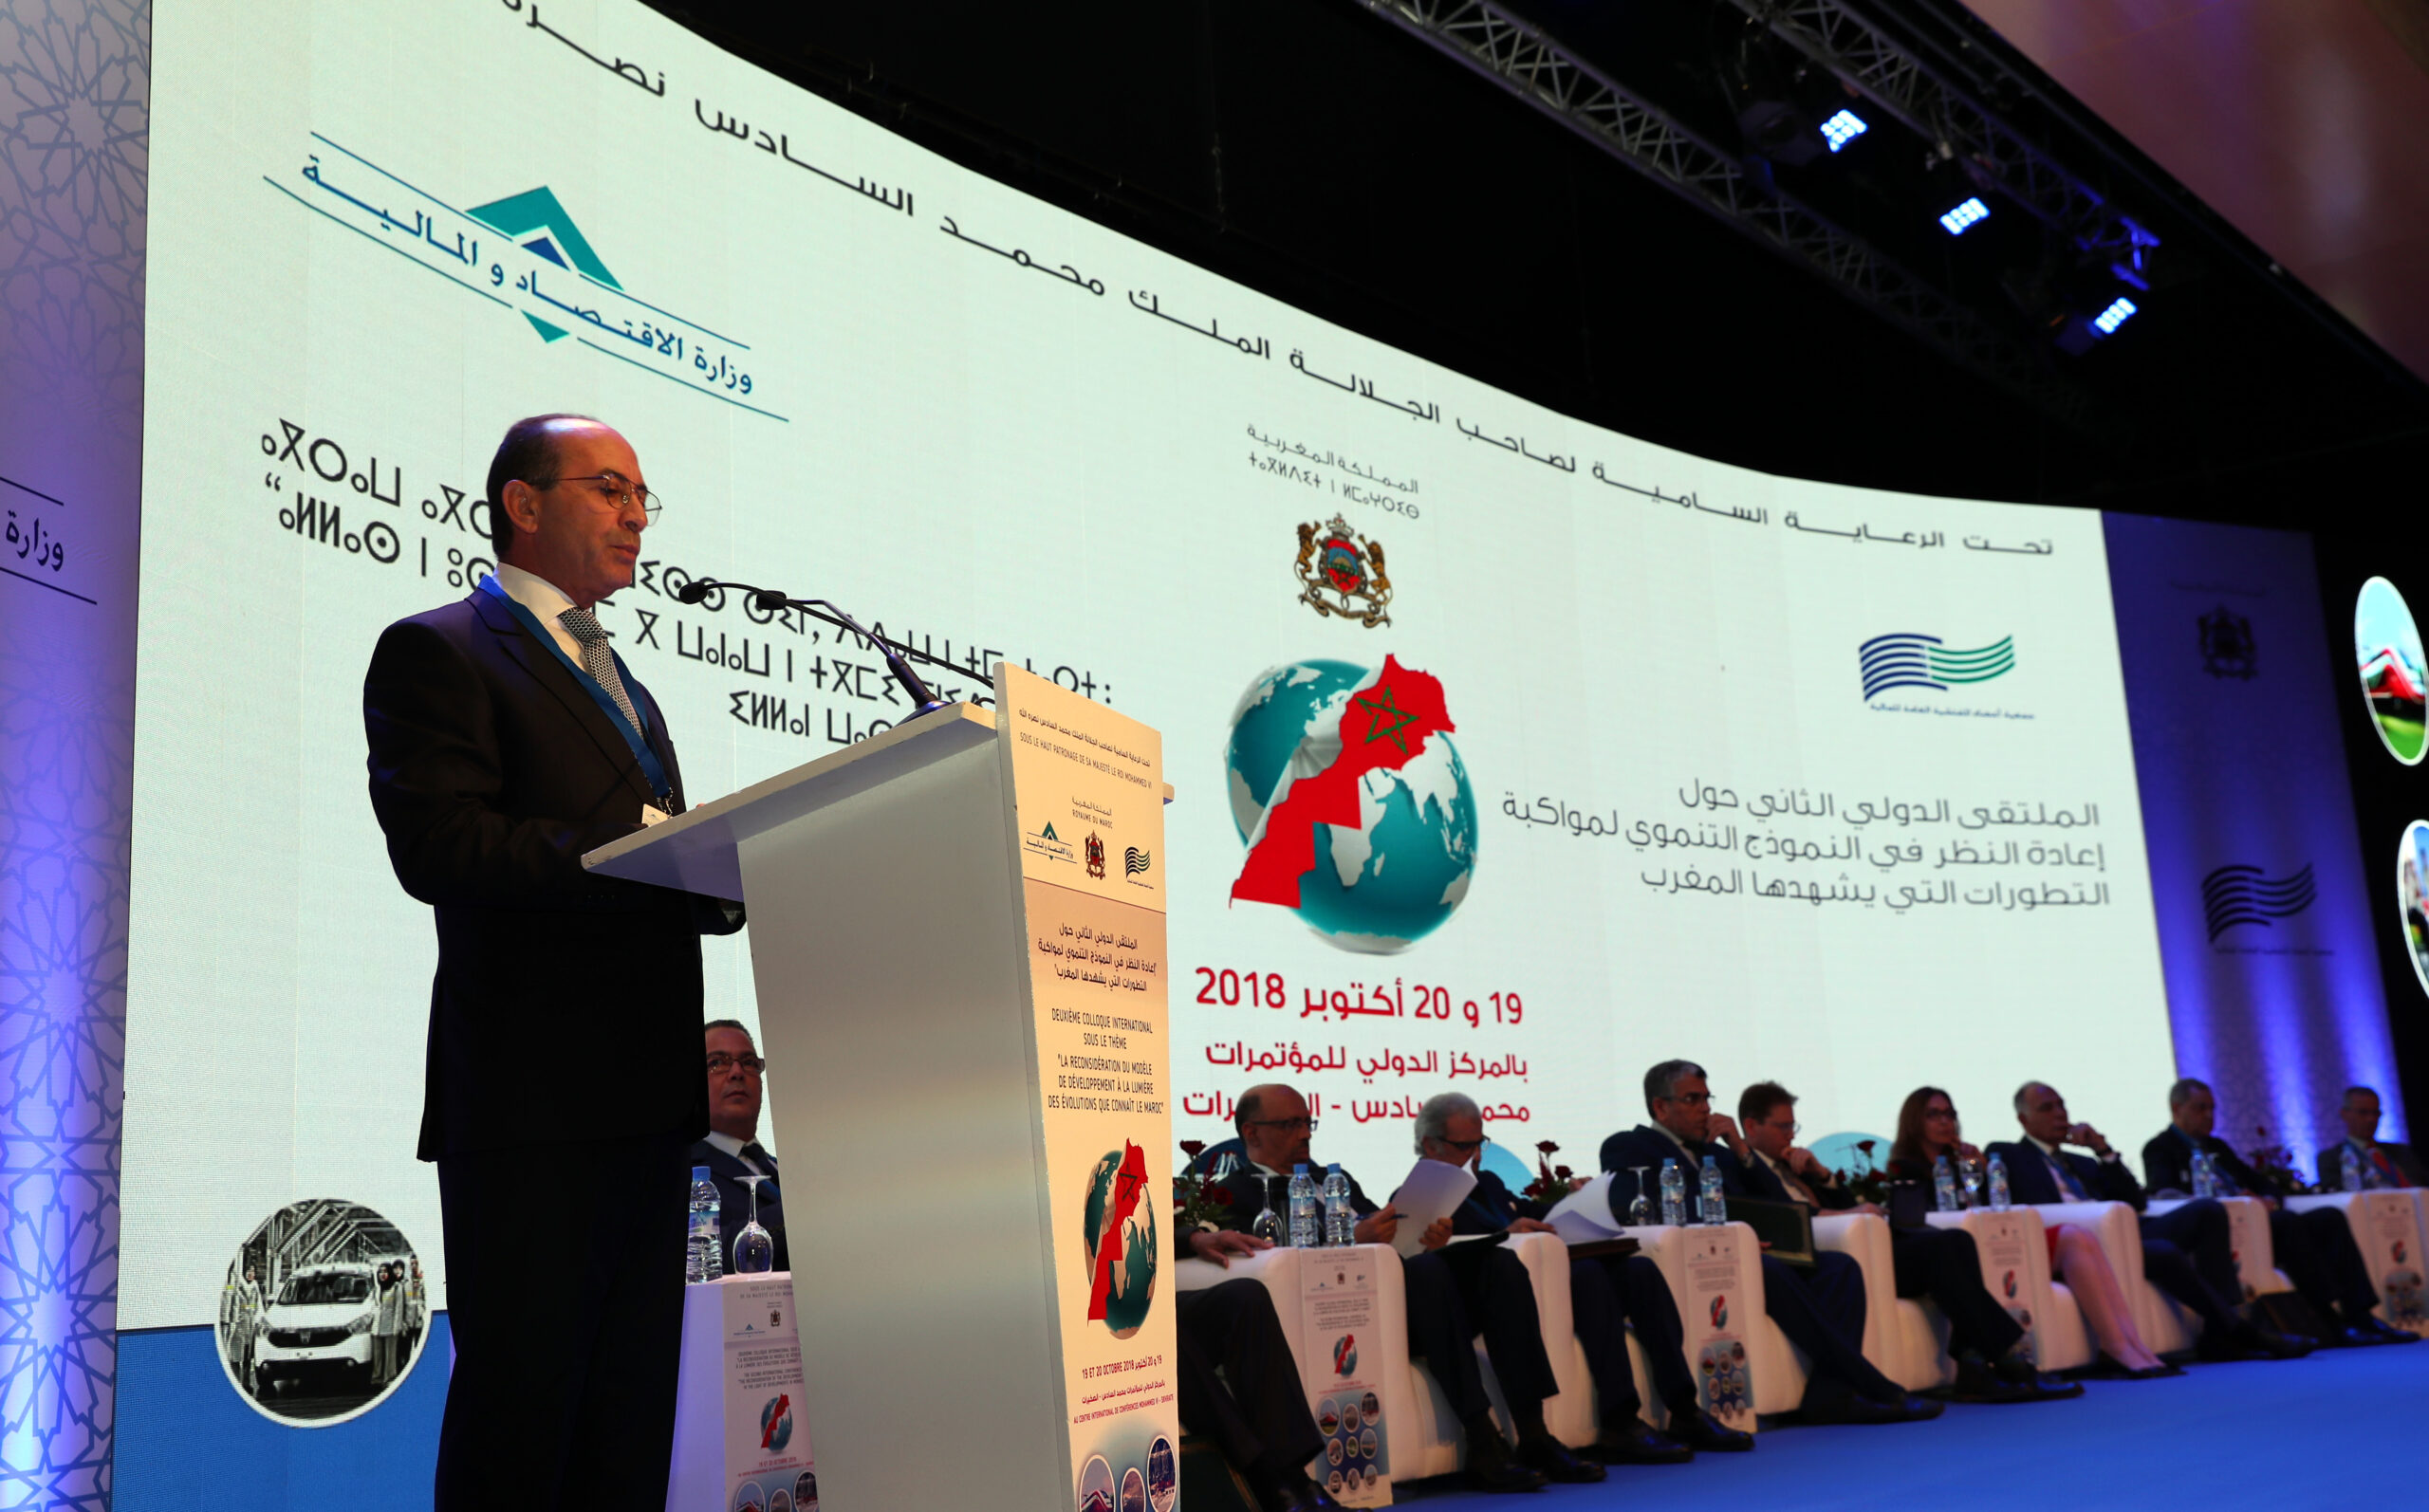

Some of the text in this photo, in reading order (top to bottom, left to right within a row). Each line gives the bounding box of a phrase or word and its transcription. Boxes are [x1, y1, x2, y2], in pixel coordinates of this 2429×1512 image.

[695, 98, 914, 218] السادس
[302, 155, 753, 396] وزارة الاقتصاد و المالية
[939, 214, 1105, 297] محمد
[1127, 286, 1271, 361] الملك
[1289, 347, 1439, 425] الجلالة
[261, 417, 401, 508] ⴰⴳⵔⴰⵡ
[1246, 423, 1419, 494] المملكة المغربية
[1456, 417, 1576, 474] لصاحب
[1592, 461, 1769, 526] السامية
[5, 508, 65, 573] وزارة
[1783, 509, 1944, 548] الرعاية
[1962, 533, 2054, 556] تحت
[1019, 731, 1033, 745] SOUS
[1033, 737, 1040, 747] LE
[1040, 740, 1053, 752] HAUT
[1053, 744, 1080, 763] PATRONAGE
[1079, 753, 1085, 765] DE
[1085, 756, 1093, 767] SA
[1111, 767, 1117, 777] LE
[1071, 808, 1091, 823] ROYAUME
[1092, 815, 1099, 825] DU
[1679, 776, 2100, 830] الملتقى الدولي الثاني حول
[1502, 790, 2105, 872] إعادة النظر في النموذج التنموي لمواكبة
[1641, 864, 2110, 916] التطورات التي يشهدها المغرب
[1058, 922, 1139, 950] الملتقى الدولي الثاني حول
[1108, 973, 1122, 992] التي
[1113, 955, 1124, 972] في
[1050, 1006, 1153, 1035] DEUXIÈME COLLOQUE INTERNATIONAL
[1195, 967, 1524, 1028] 19 و 20 أكتوبر 2018
[1083, 1032, 1127, 1050] SOUS LE THÈME
[1205, 1040, 1529, 1084] بالمركز الدولي للمؤتمرات
[1057, 1053, 1153, 1076] "LA RECONSIDÉRATION DU MODÈLE
[1058, 1073, 1154, 1095] DE DÉVELOPPEMENT À LA LUMIÈRE
[1048, 1093, 1164, 1115] DES ÉVOLUTIONS QUE CONNAÎT LE MAROC"
[1481, 1103, 1530, 1122] محم
[1082, 1358, 1135, 1379] 19 ET 20 OCTOBRE 2018
